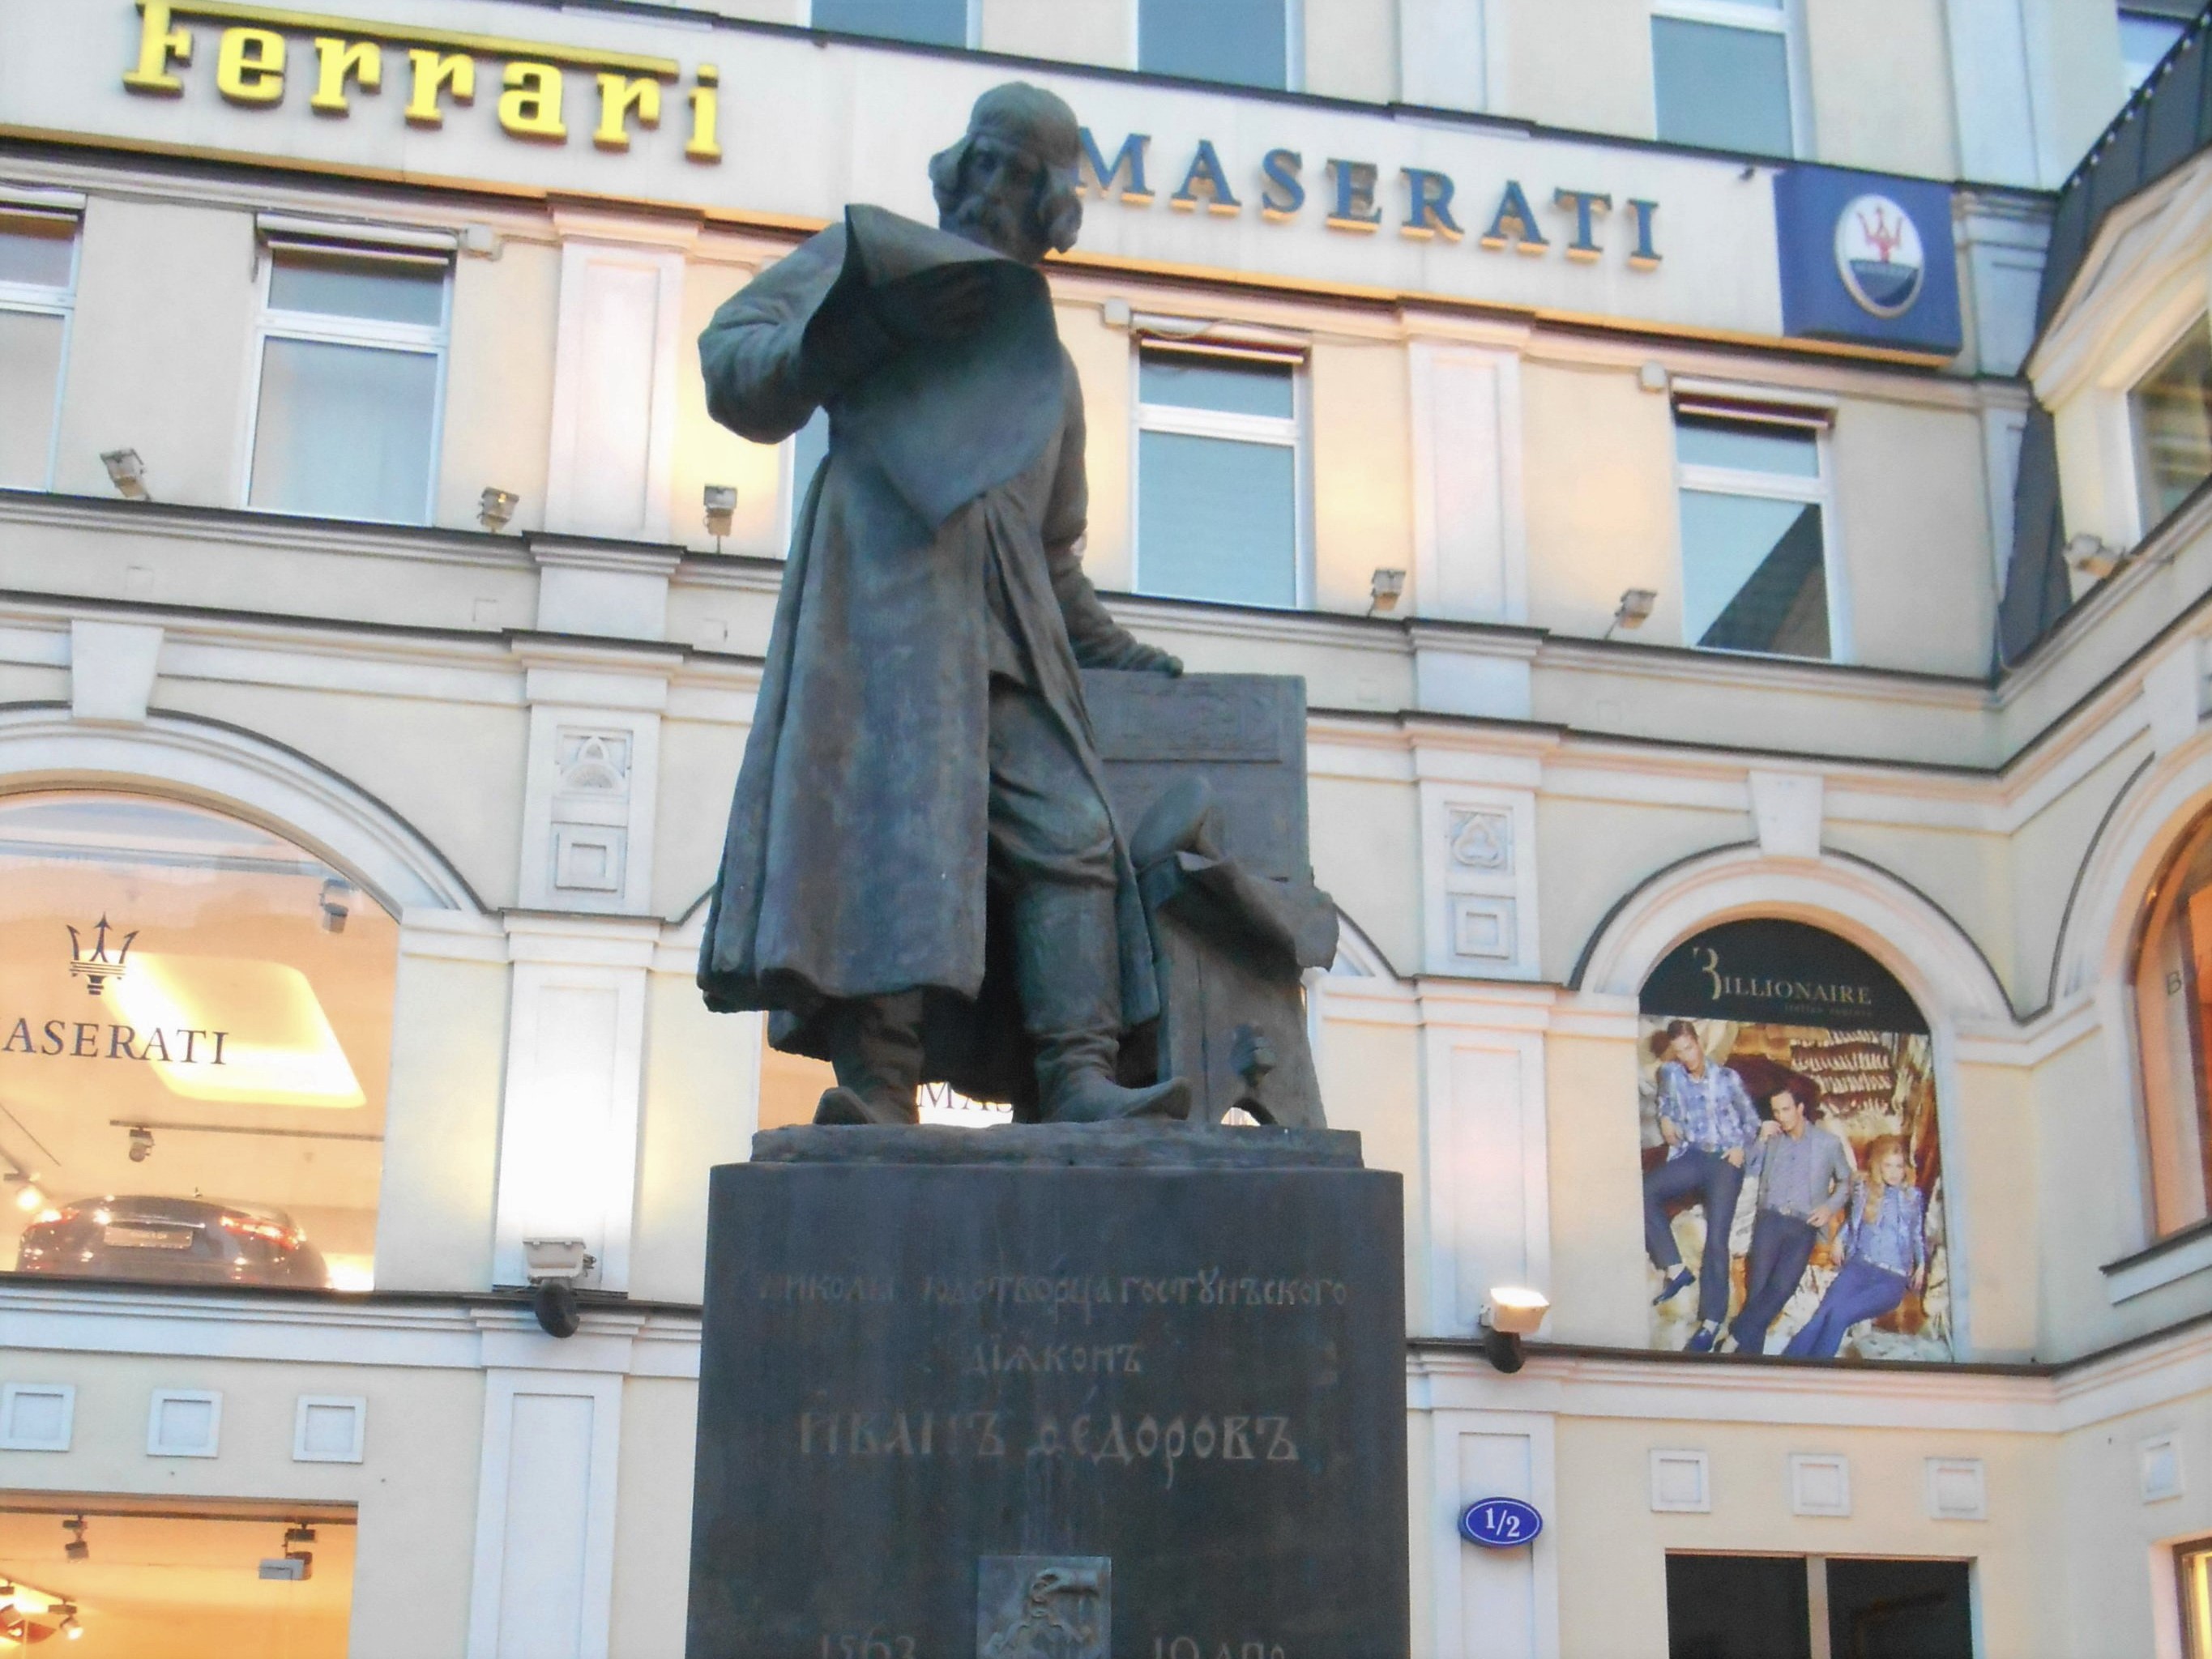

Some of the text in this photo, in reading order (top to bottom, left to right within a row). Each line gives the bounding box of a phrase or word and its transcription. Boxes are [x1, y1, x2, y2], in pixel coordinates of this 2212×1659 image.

[122, 0, 724, 163] Ferrari
[1072, 125, 1663, 269] MASERATI
[1693, 947, 1873, 1005] BILLIONAIRE
[1485, 1508, 1520, 1537] 1/2
